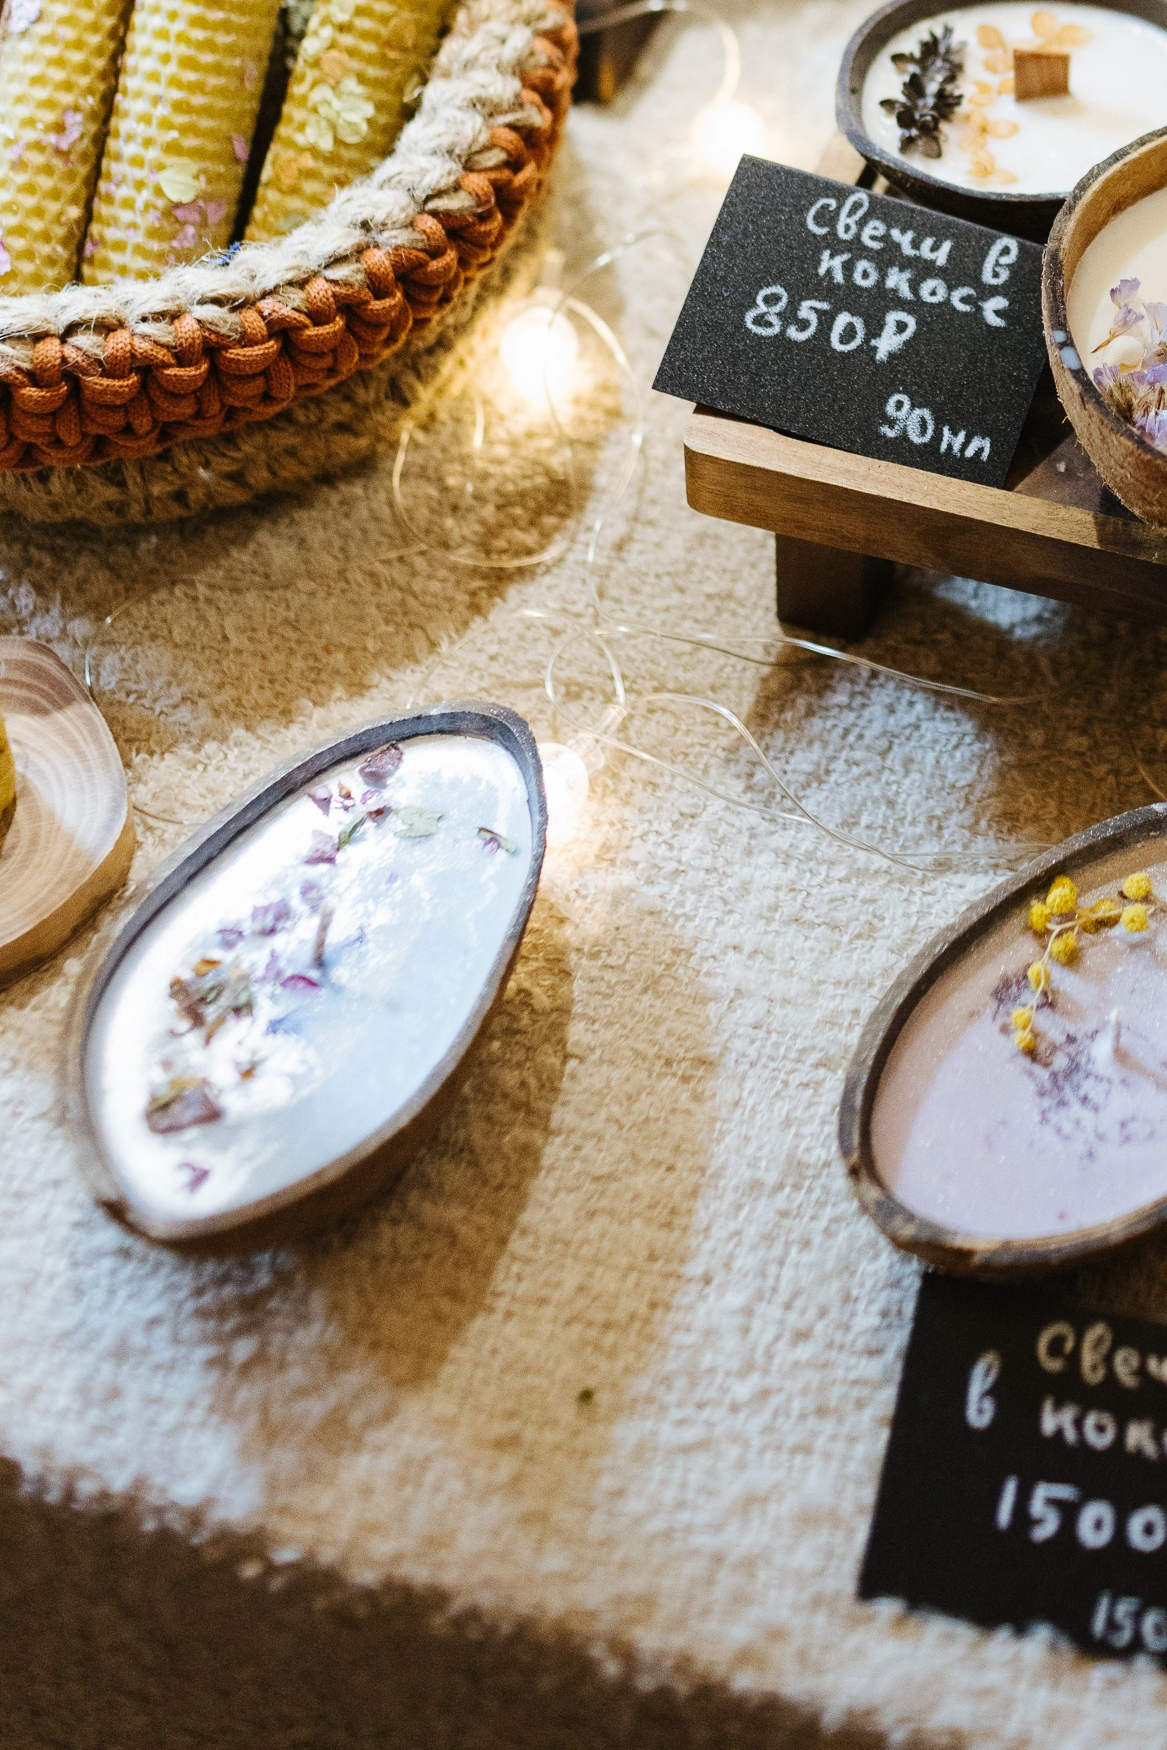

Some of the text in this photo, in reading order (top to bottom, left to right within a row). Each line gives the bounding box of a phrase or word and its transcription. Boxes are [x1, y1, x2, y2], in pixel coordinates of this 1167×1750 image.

[818, 250, 1010, 327] кокосе
[982, 236, 1019, 285] в
[965, 1351, 1001, 1429] в
